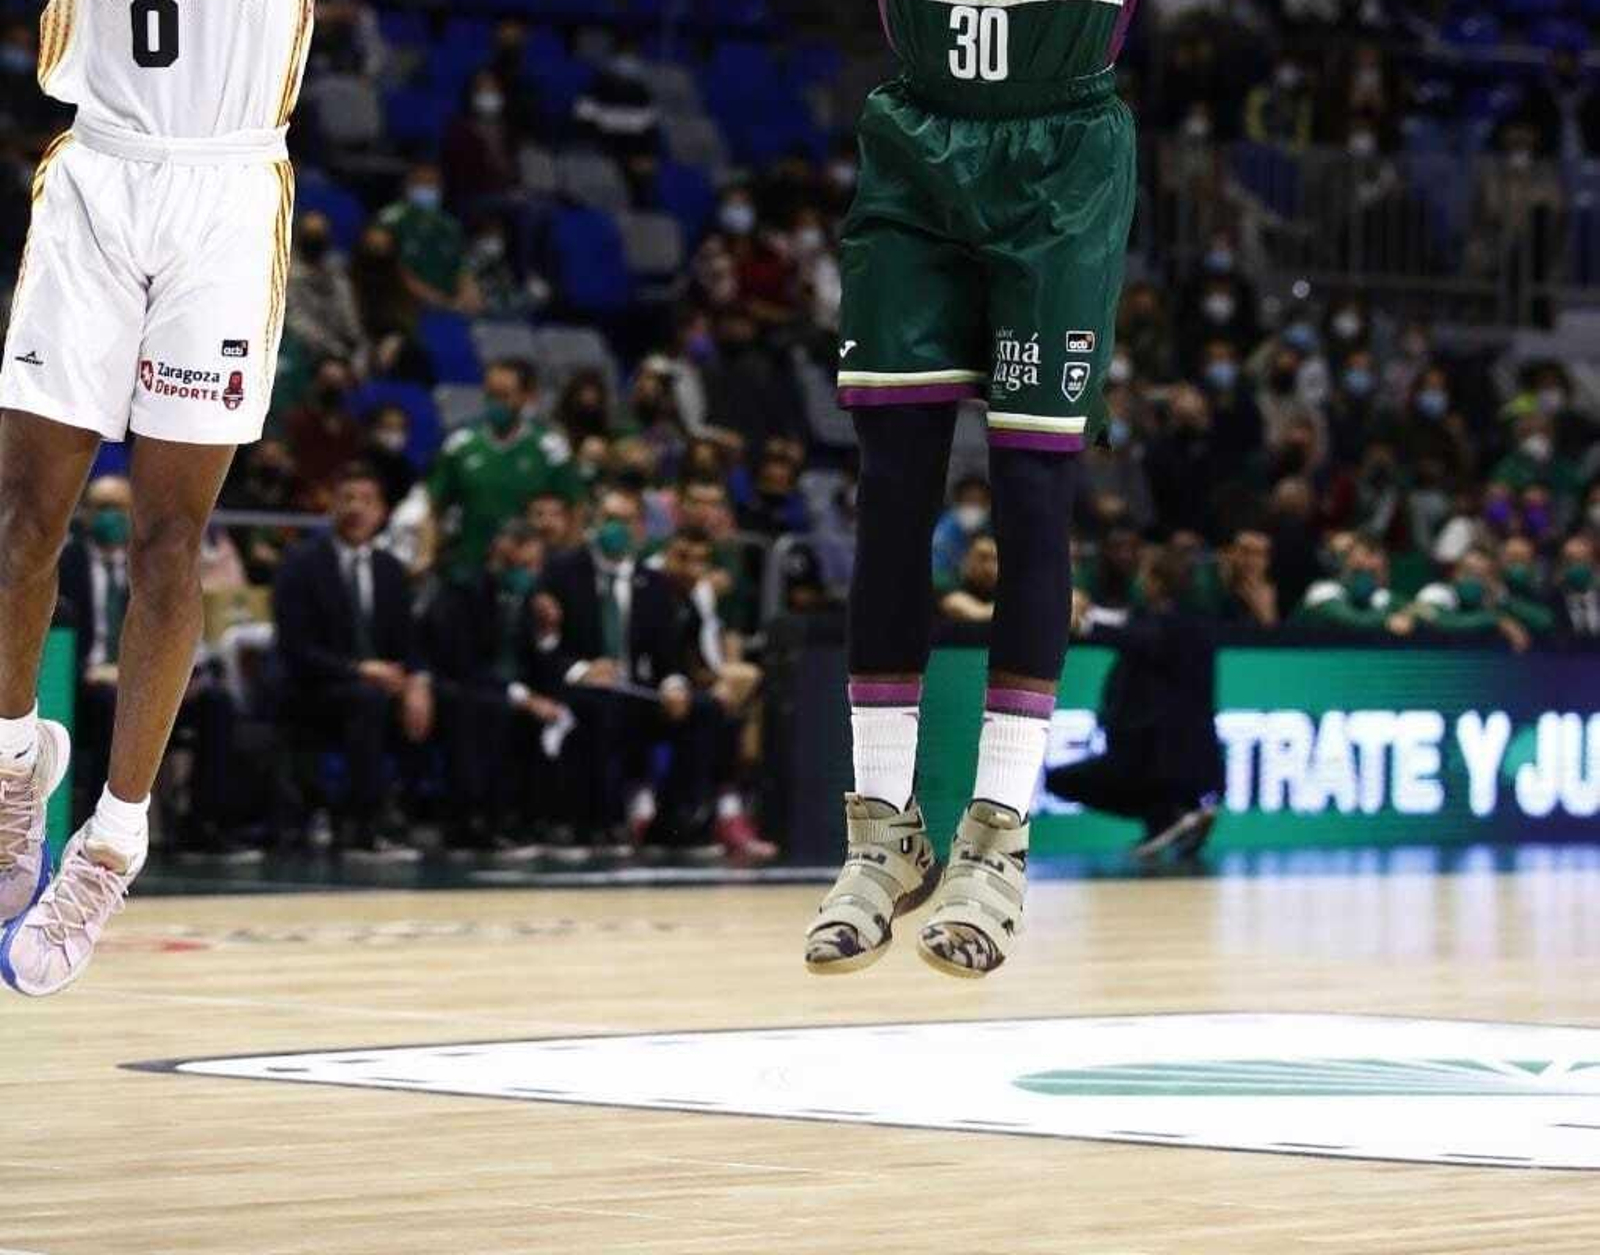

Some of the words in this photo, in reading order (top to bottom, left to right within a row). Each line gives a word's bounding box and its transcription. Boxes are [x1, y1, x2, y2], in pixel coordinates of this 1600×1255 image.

[948, 6, 1009, 81] 30
[157, 362, 220, 385] Zaragoza
[1456, 709, 1510, 818] Y
